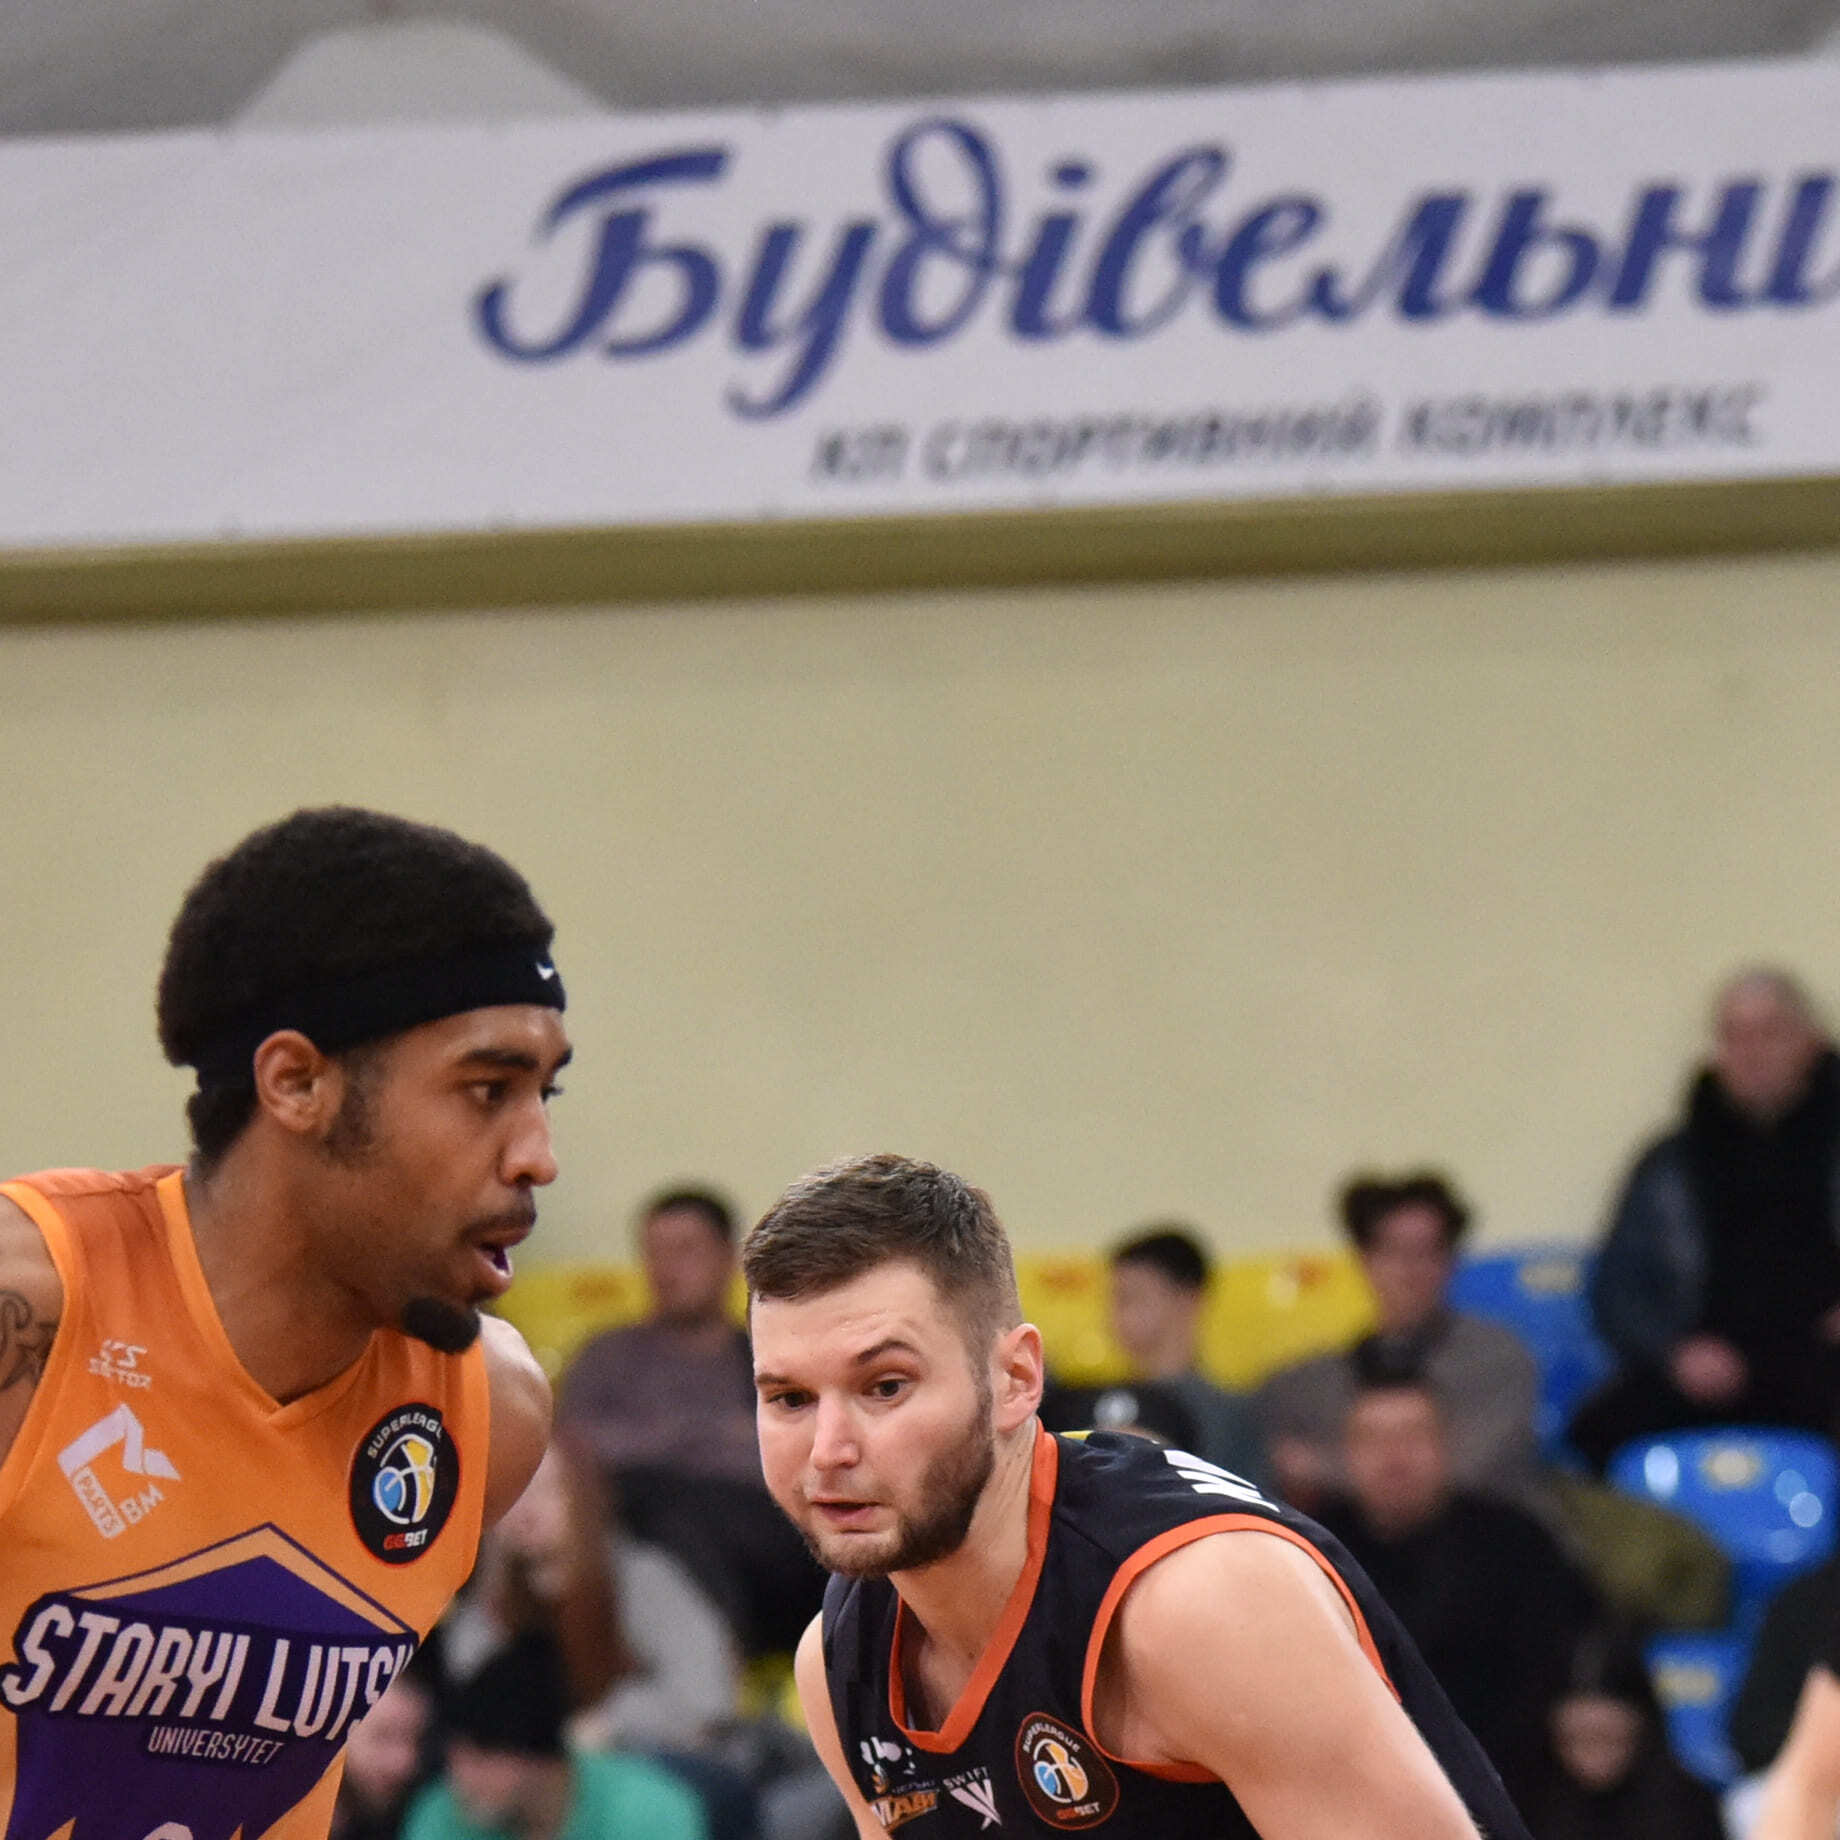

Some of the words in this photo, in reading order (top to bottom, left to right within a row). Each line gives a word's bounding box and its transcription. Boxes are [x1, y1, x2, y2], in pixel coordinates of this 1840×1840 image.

[367, 1411, 443, 1459] SUPERLEAGU
[118, 1482, 165, 1525] BM
[2, 1603, 251, 1720] STARYI
[147, 1726, 285, 1766] UNIVERSYTET
[943, 1766, 989, 1789] SWIFT
